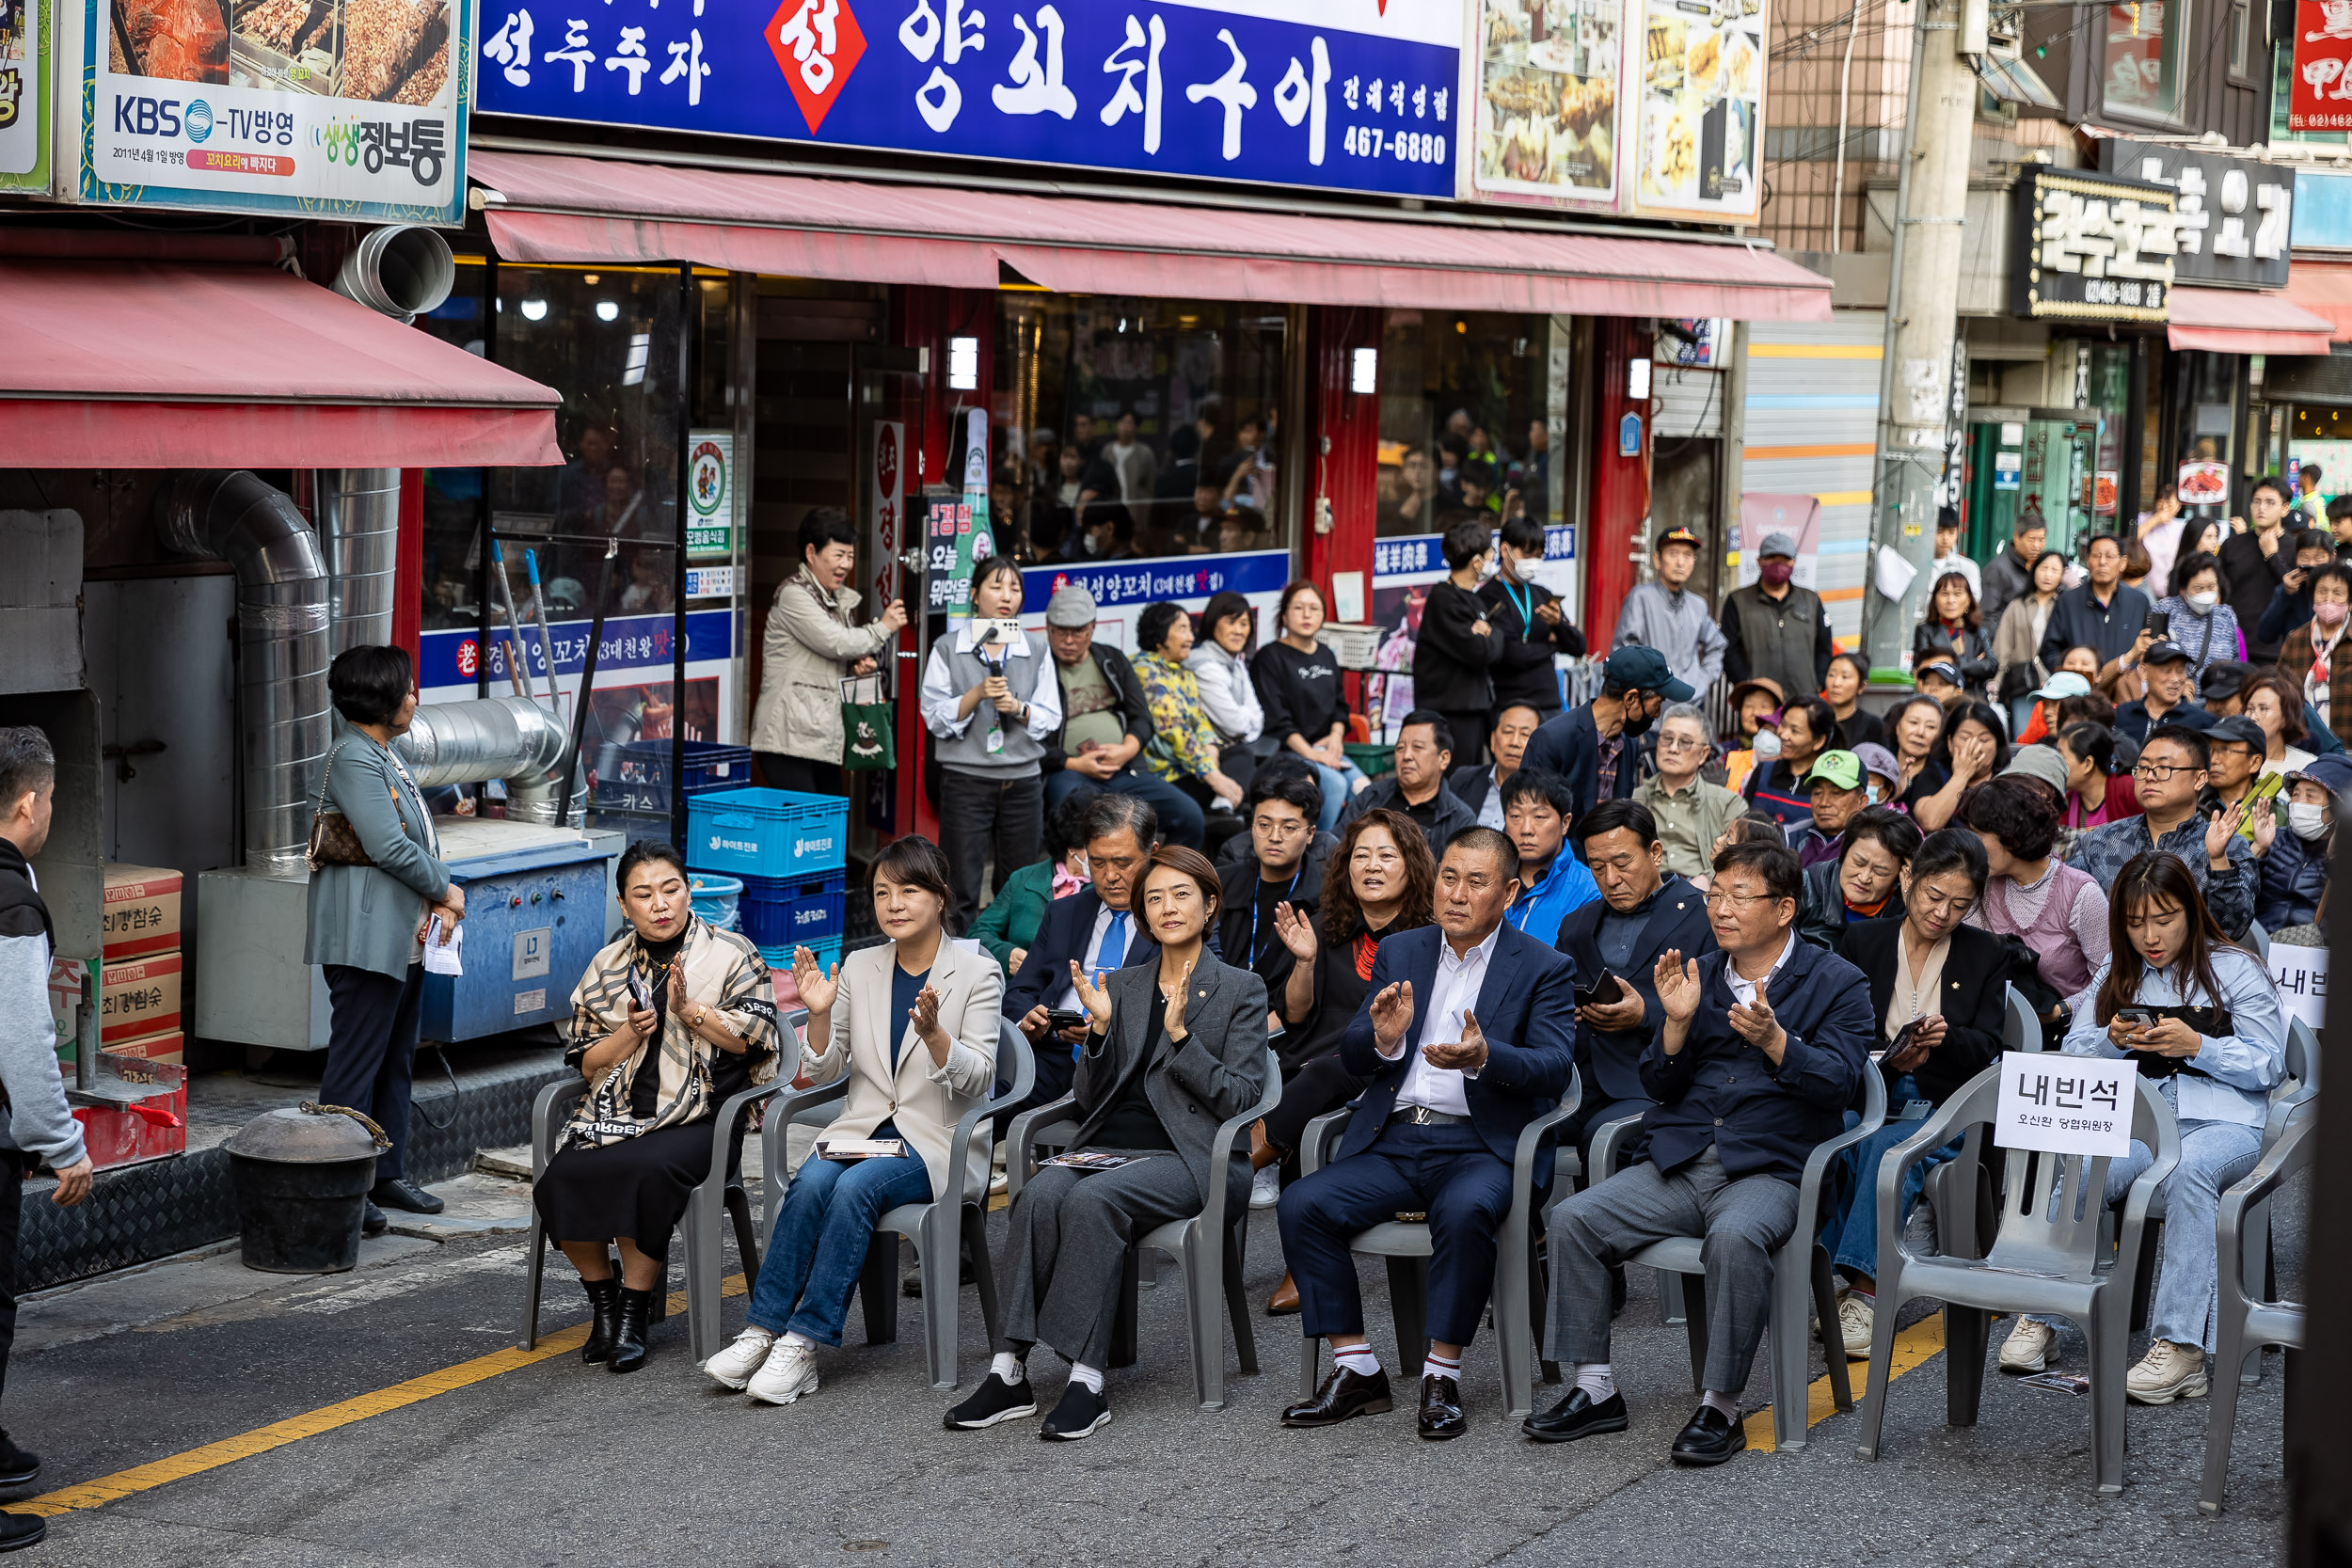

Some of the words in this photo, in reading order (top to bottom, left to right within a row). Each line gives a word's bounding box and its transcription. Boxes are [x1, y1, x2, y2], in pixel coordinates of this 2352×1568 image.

[114, 94, 181, 138] KBS
[112, 147, 140, 162] 2011년
[140, 150, 154, 163] 4월
[155, 150, 168, 164] 1일
[168, 151, 185, 166] 방영
[1343, 125, 1446, 165] 467-6880
[205, 151, 249, 171] 꼬치요리에
[249, 156, 278, 174] 빠지다
[930, 544, 959, 571] 오늘
[623, 793, 653, 811] 카스
[103, 987, 162, 1014] 최강참숯
[2018, 1072, 2119, 1111] 내빈석
[2017, 1113, 2053, 1128] 오신환
[2058, 1117, 2114, 1132] 당협위원장
